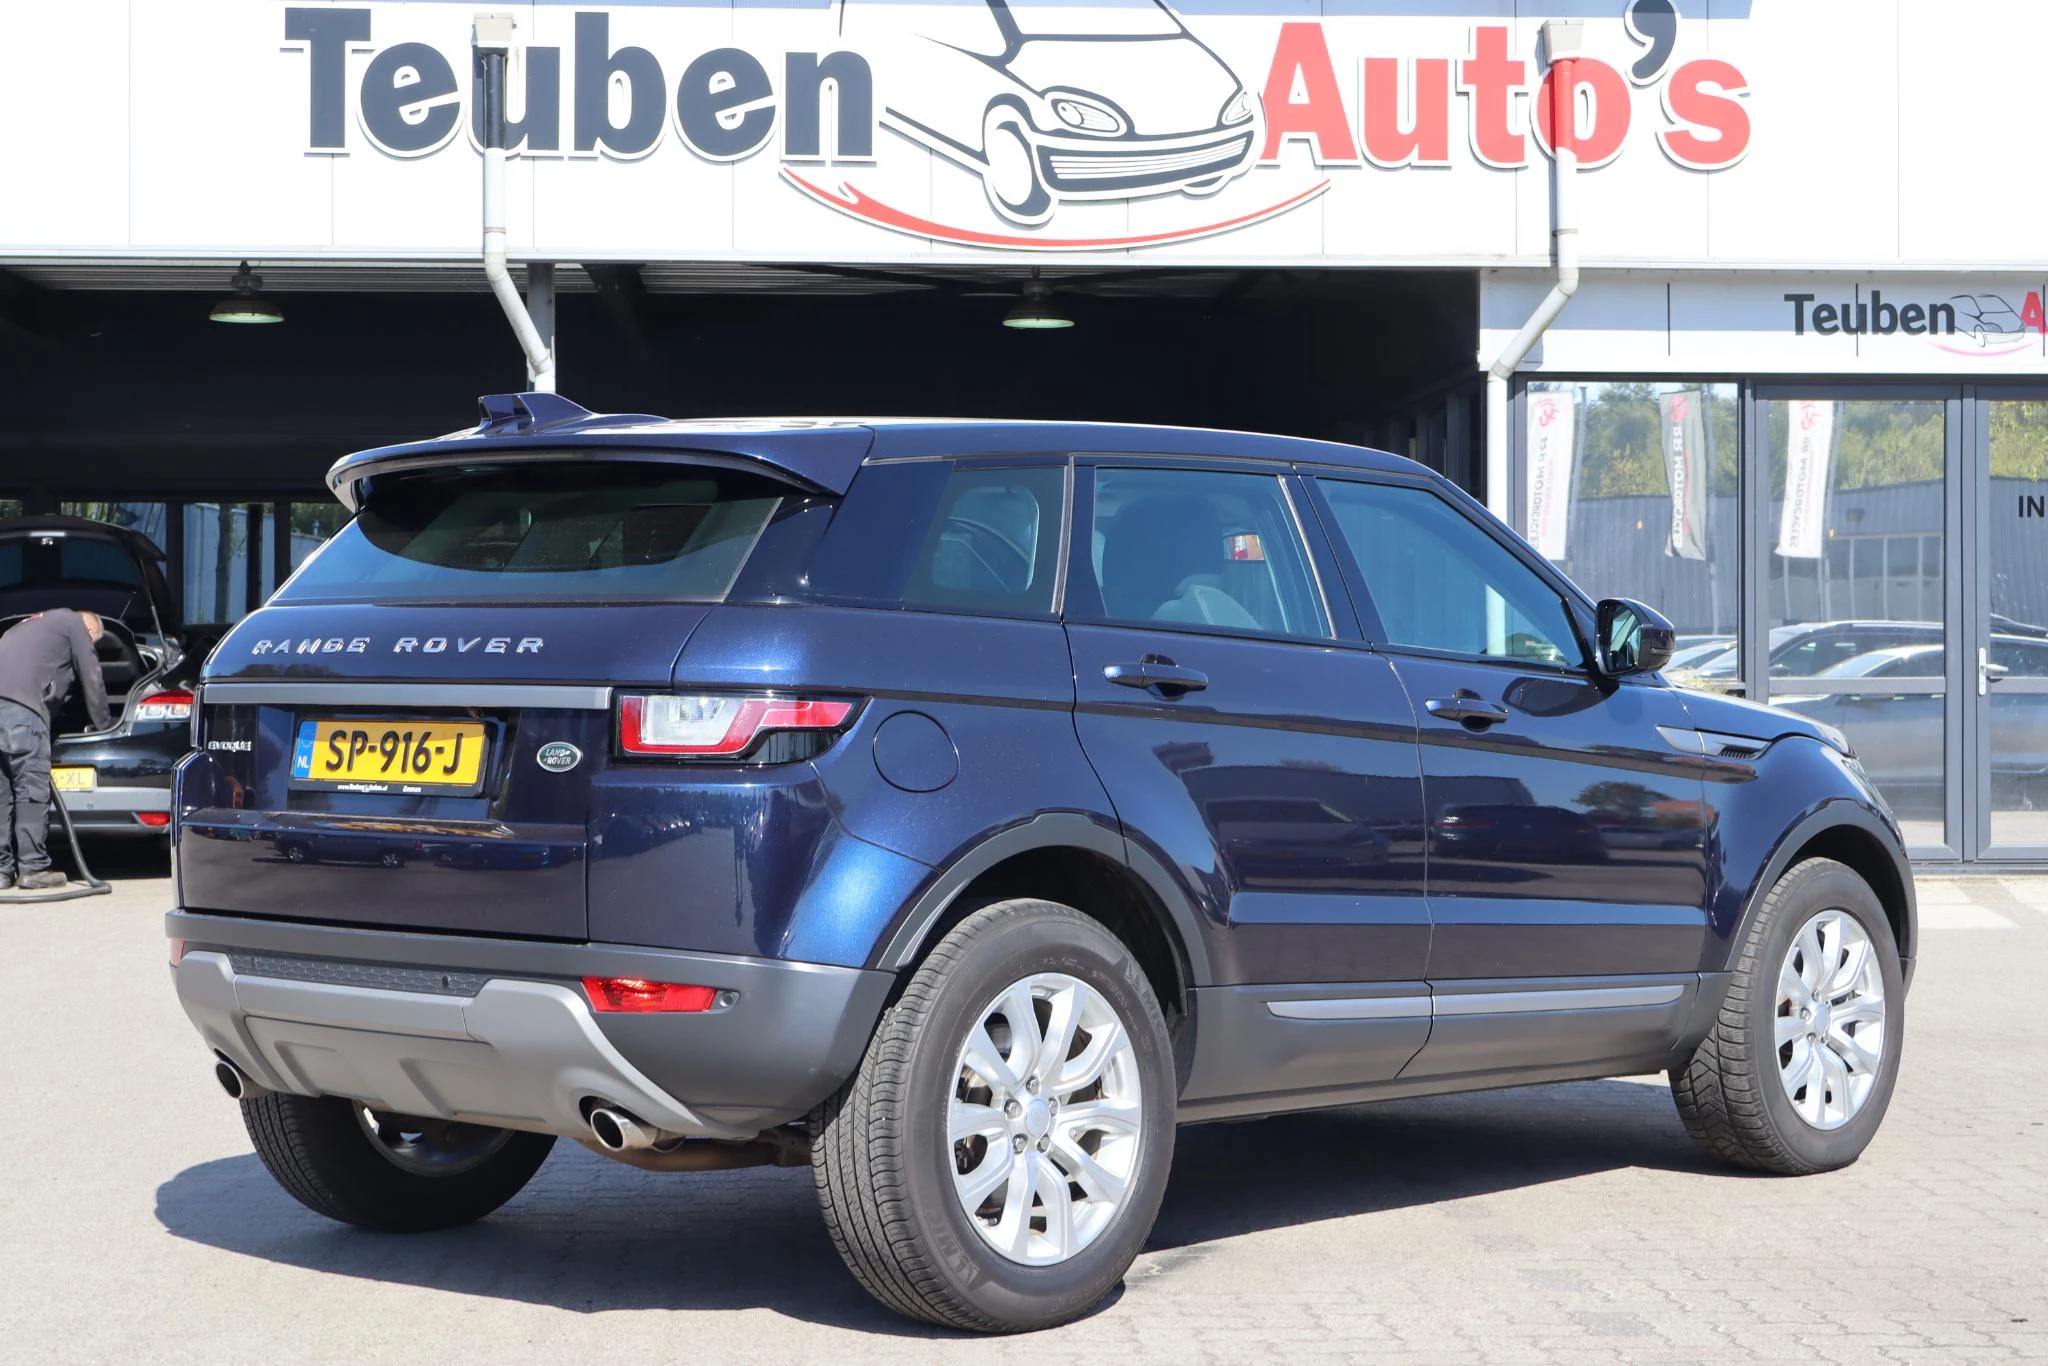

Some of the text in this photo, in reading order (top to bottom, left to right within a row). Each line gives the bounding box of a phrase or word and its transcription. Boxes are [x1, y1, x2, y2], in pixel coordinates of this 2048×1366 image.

[283, 0, 1752, 165] Teuben Auto's
[1783, 290, 1955, 336] Teuben
[2018, 495, 2044, 518] IN
[251, 635, 544, 655] RANGE ROVER
[297, 755, 309, 769] NL
[325, 729, 464, 776] SP-916-J
[545, 748, 566, 757] LAND
[546, 756, 571, 765] ROVER
